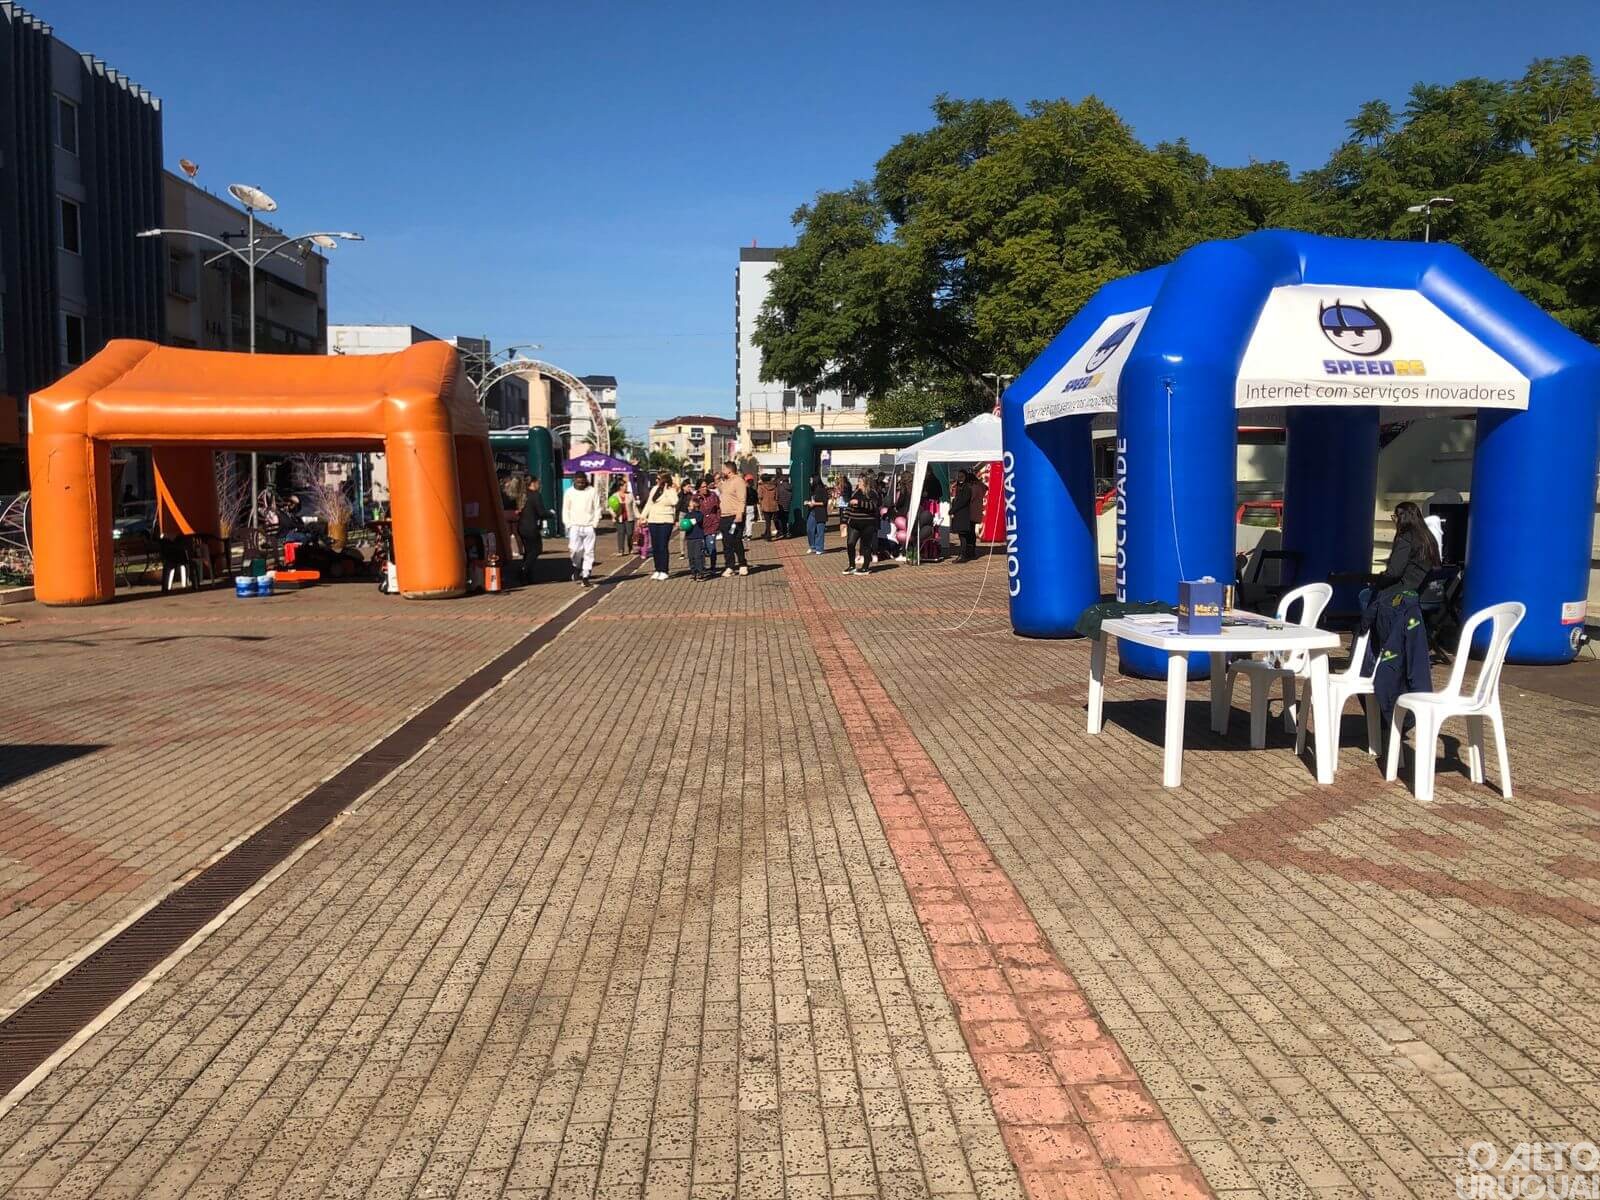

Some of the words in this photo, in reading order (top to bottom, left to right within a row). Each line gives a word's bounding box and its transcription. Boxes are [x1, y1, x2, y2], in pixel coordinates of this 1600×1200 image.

[1323, 359, 1426, 376] SPEEDRS
[1245, 384, 1312, 399] Internet
[1316, 386, 1348, 398] com
[1352, 384, 1419, 402] serviços
[1425, 384, 1516, 400] inovadores
[1116, 438, 1127, 603] ELOCIDADE
